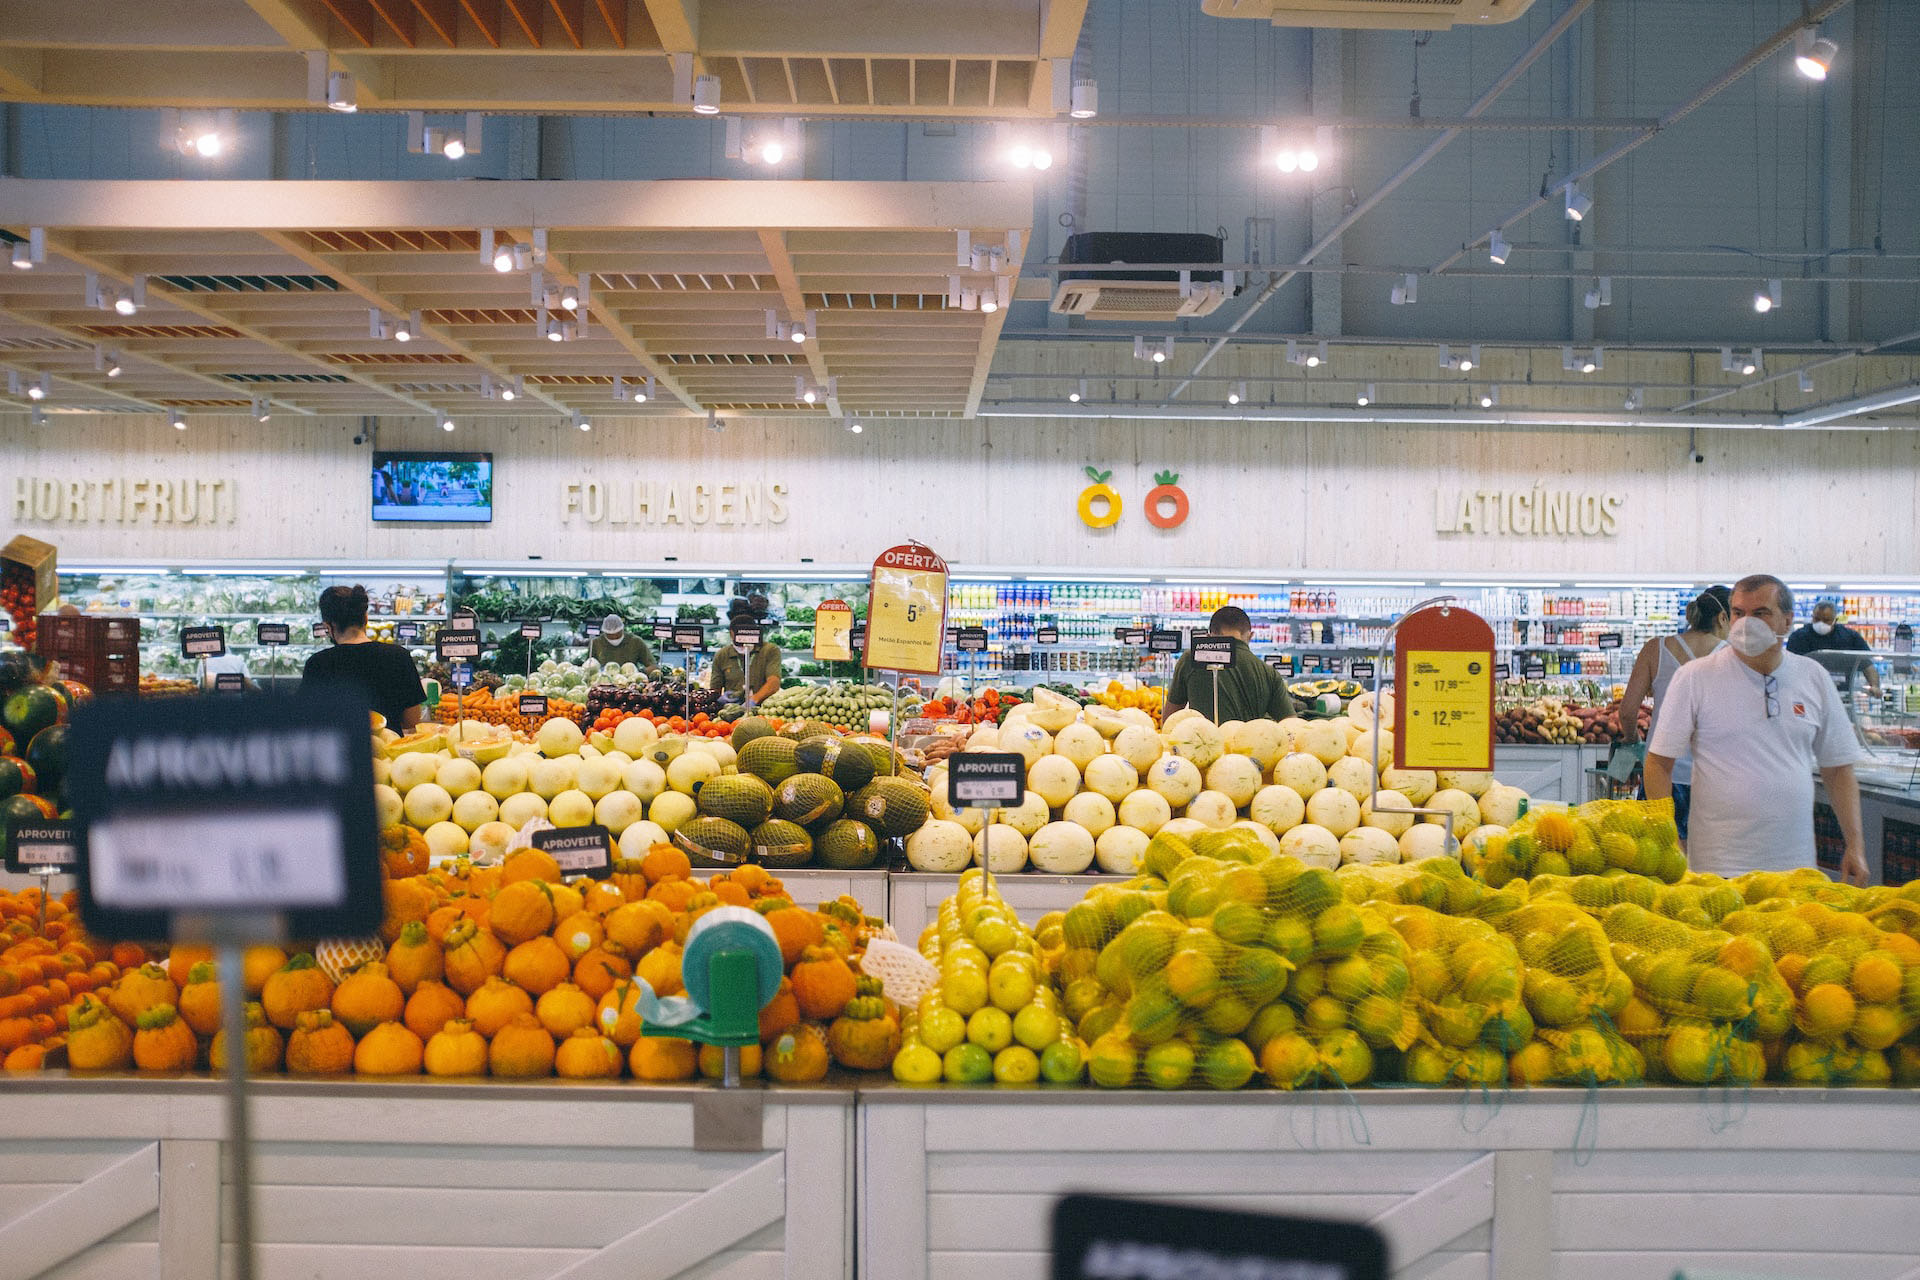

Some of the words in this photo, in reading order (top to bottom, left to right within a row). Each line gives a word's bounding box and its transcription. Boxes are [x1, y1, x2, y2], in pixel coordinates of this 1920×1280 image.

[14, 477, 240, 524] HORTIFRUTI
[561, 479, 789, 525] FOLHAGENS
[1435, 479, 1627, 536] LATICÍNIOS
[885, 552, 941, 569] OFERTA
[821, 603, 850, 611] OFERTA
[957, 763, 1017, 773] APROVEITE
[17, 829, 71, 839] APROVEIT
[542, 835, 602, 850] APROVEITE
